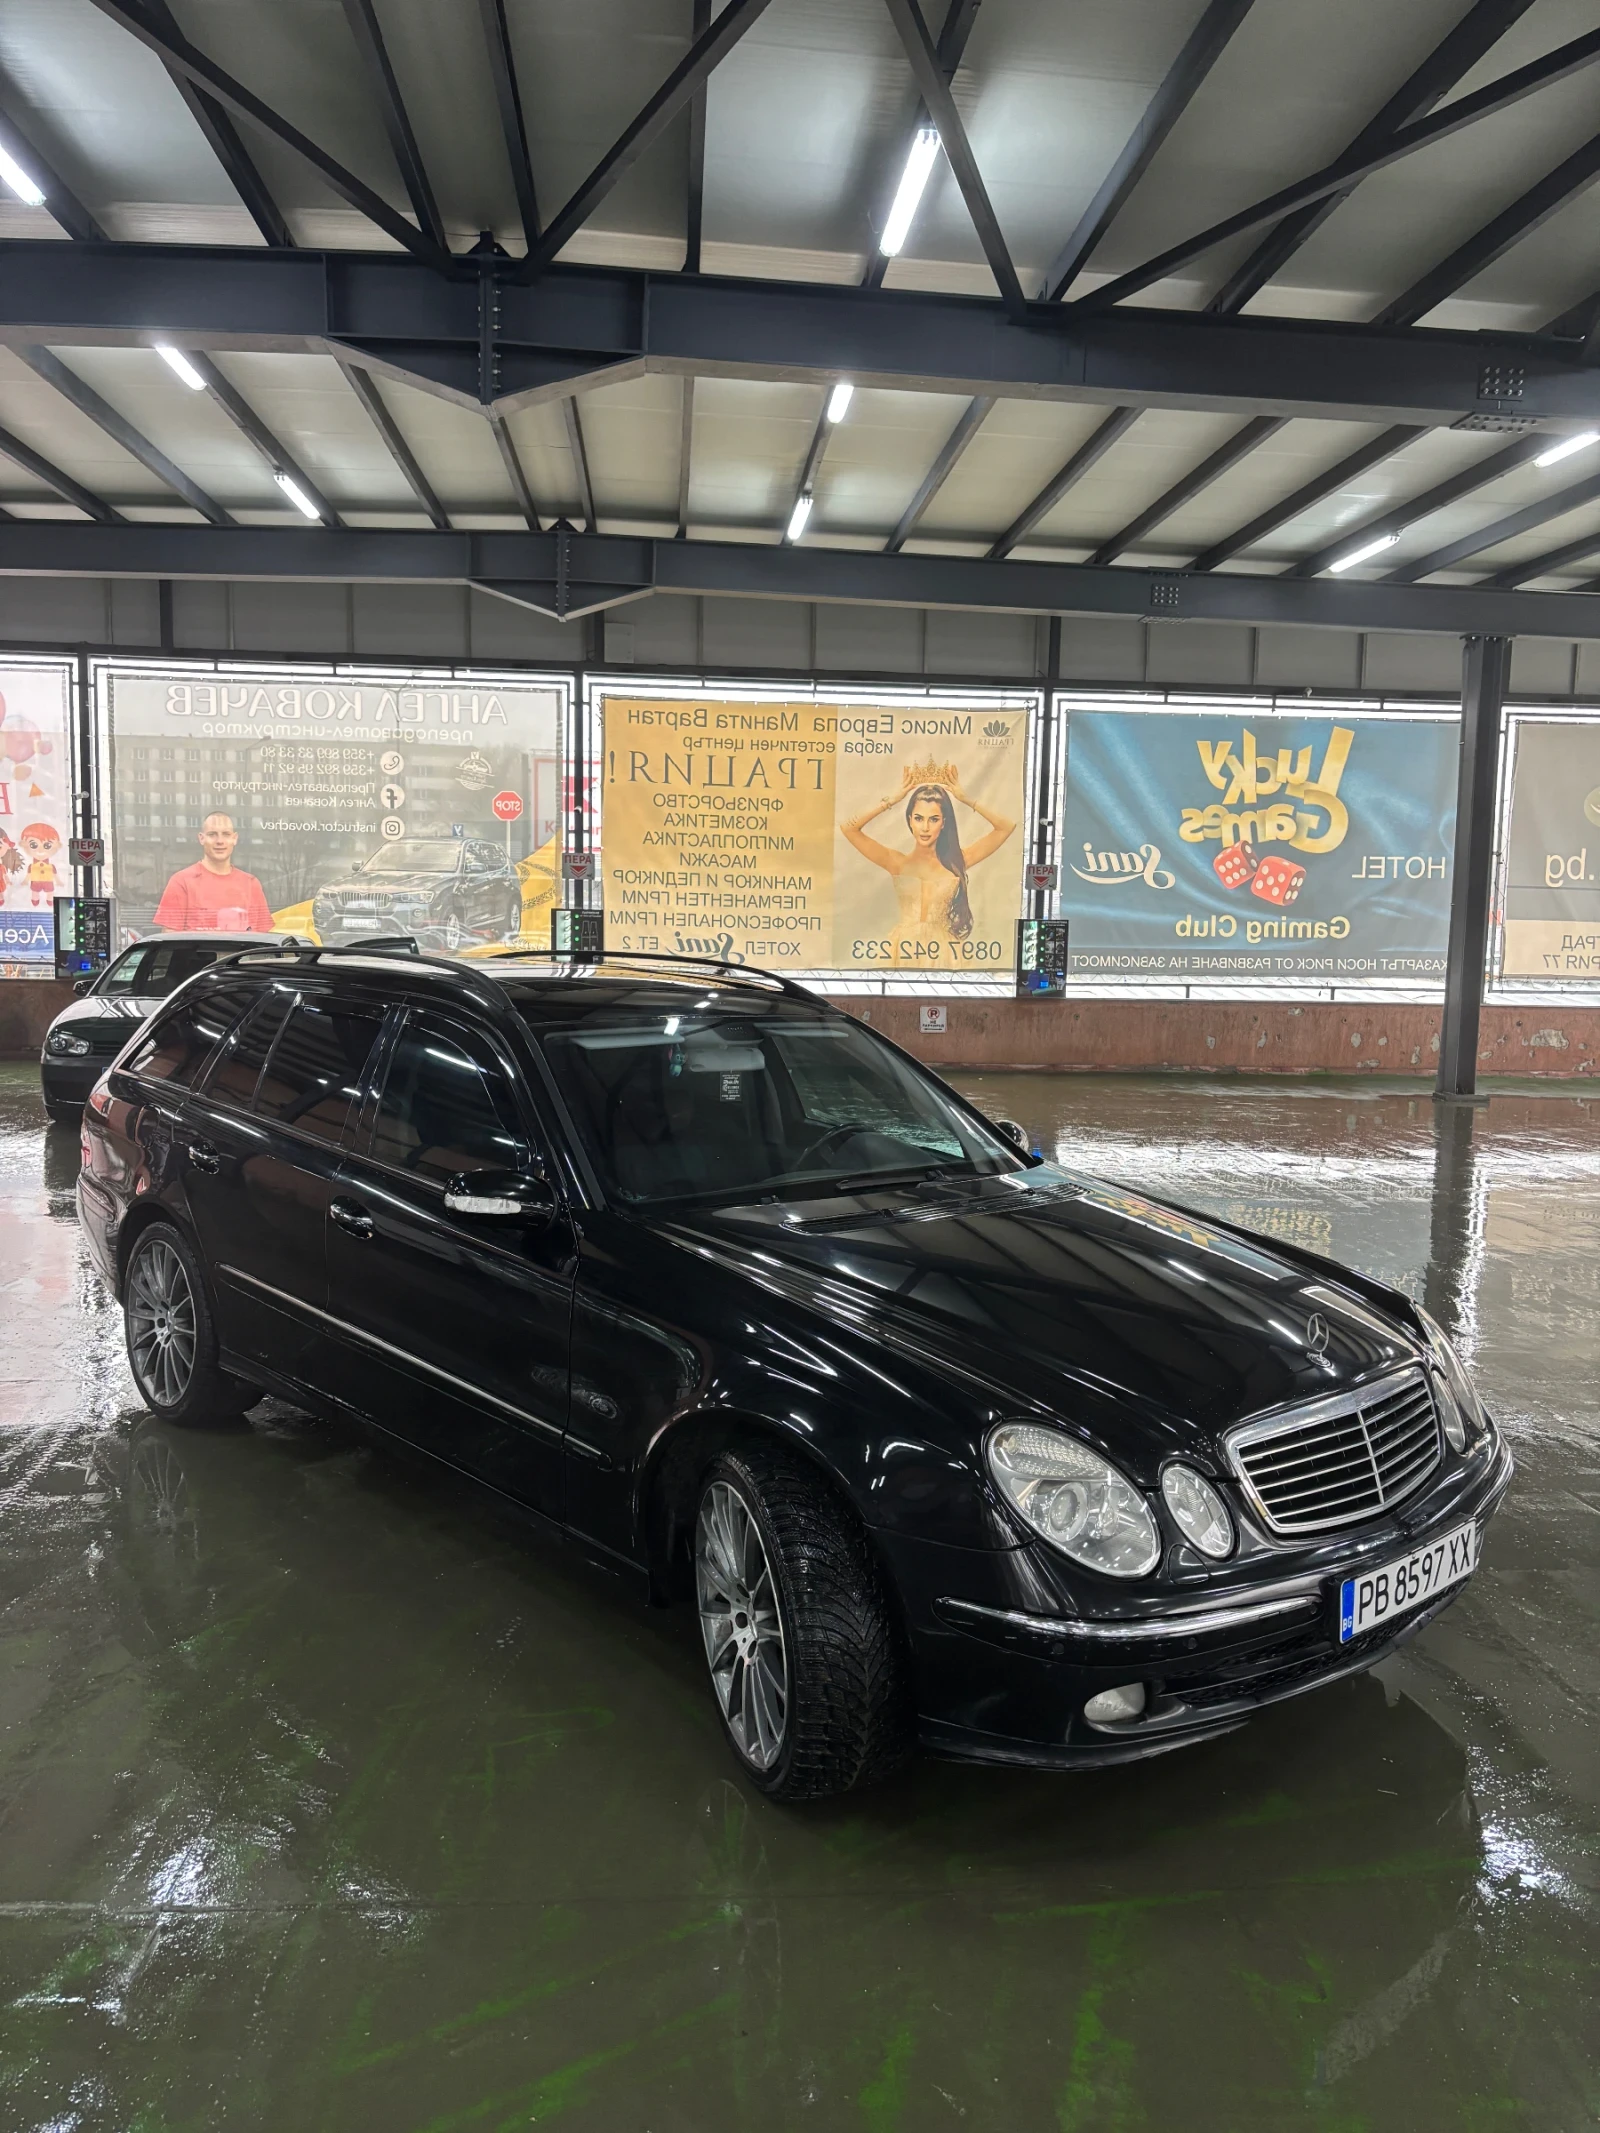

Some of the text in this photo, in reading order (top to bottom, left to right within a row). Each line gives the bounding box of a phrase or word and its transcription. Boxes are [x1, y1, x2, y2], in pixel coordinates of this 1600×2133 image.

[71, 840, 100, 850] ПЕРА
[564, 855, 592, 864] ПЕРА
[1028, 866, 1055, 876] ПЕРА
[1358, 1528, 1471, 1625] PB 8597 XX
[1342, 1615, 1353, 1631] BG
